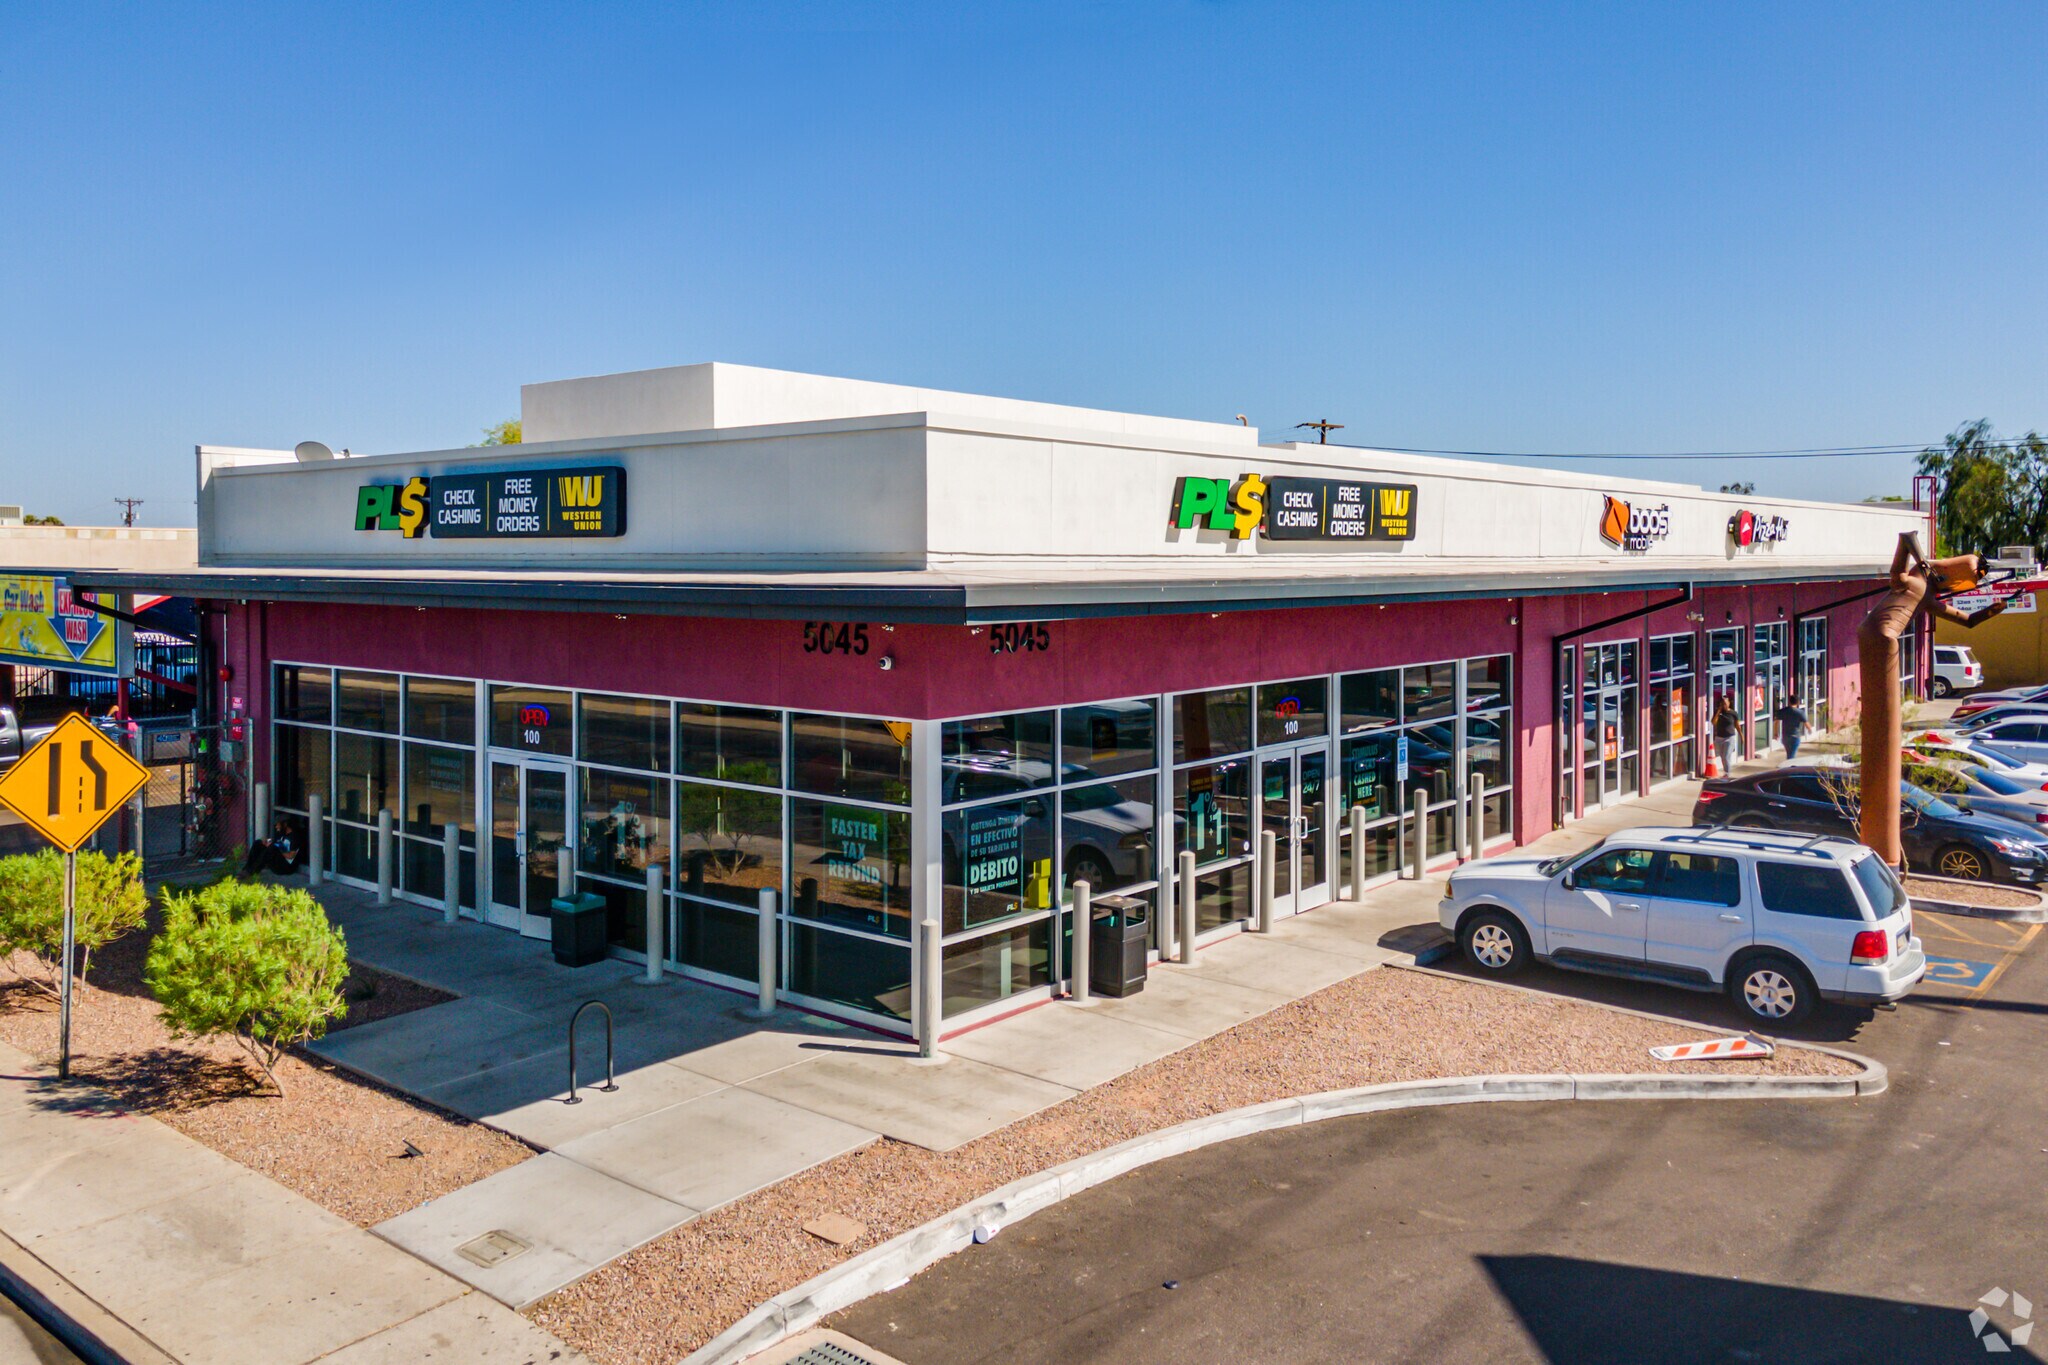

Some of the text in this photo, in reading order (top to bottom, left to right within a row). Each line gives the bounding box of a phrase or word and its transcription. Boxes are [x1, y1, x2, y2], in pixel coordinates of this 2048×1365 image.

[505, 478, 532, 495] FREE
[1338, 486, 1361, 502] FREE
[443, 490, 475, 506] CHECK
[499, 497, 538, 514] MONEY
[1283, 491, 1313, 508] CHECK
[438, 508, 482, 525] CASHING
[561, 511, 602, 521] WESTERN
[1277, 510, 1318, 528] CASHING
[1333, 503, 1365, 519] MONEY
[1630, 502, 1672, 535] boost
[496, 515, 540, 532] ORDERS
[573, 521, 602, 531] UNION
[1330, 520, 1365, 536] ORDERS
[1381, 518, 1408, 528] WESTERN
[1388, 527, 1408, 536] UNION
[4, 588, 45, 613] Car Wash
[65, 618, 88, 644] WASH
[803, 621, 869, 656] 5045
[989, 622, 1050, 654] 5045
[520, 708, 548, 726] OPEN
[1284, 720, 1299, 735] 100
[524, 729, 540, 744] 100
[1353, 772, 1376, 786] CASHED
[1357, 785, 1373, 799] HERE
[831, 818, 878, 841] FASTER
[971, 826, 1018, 846] EN EFECTIVO
[842, 840, 867, 861] TAX
[828, 859, 880, 884] REFUND
[970, 855, 1019, 884] DÉBITO
